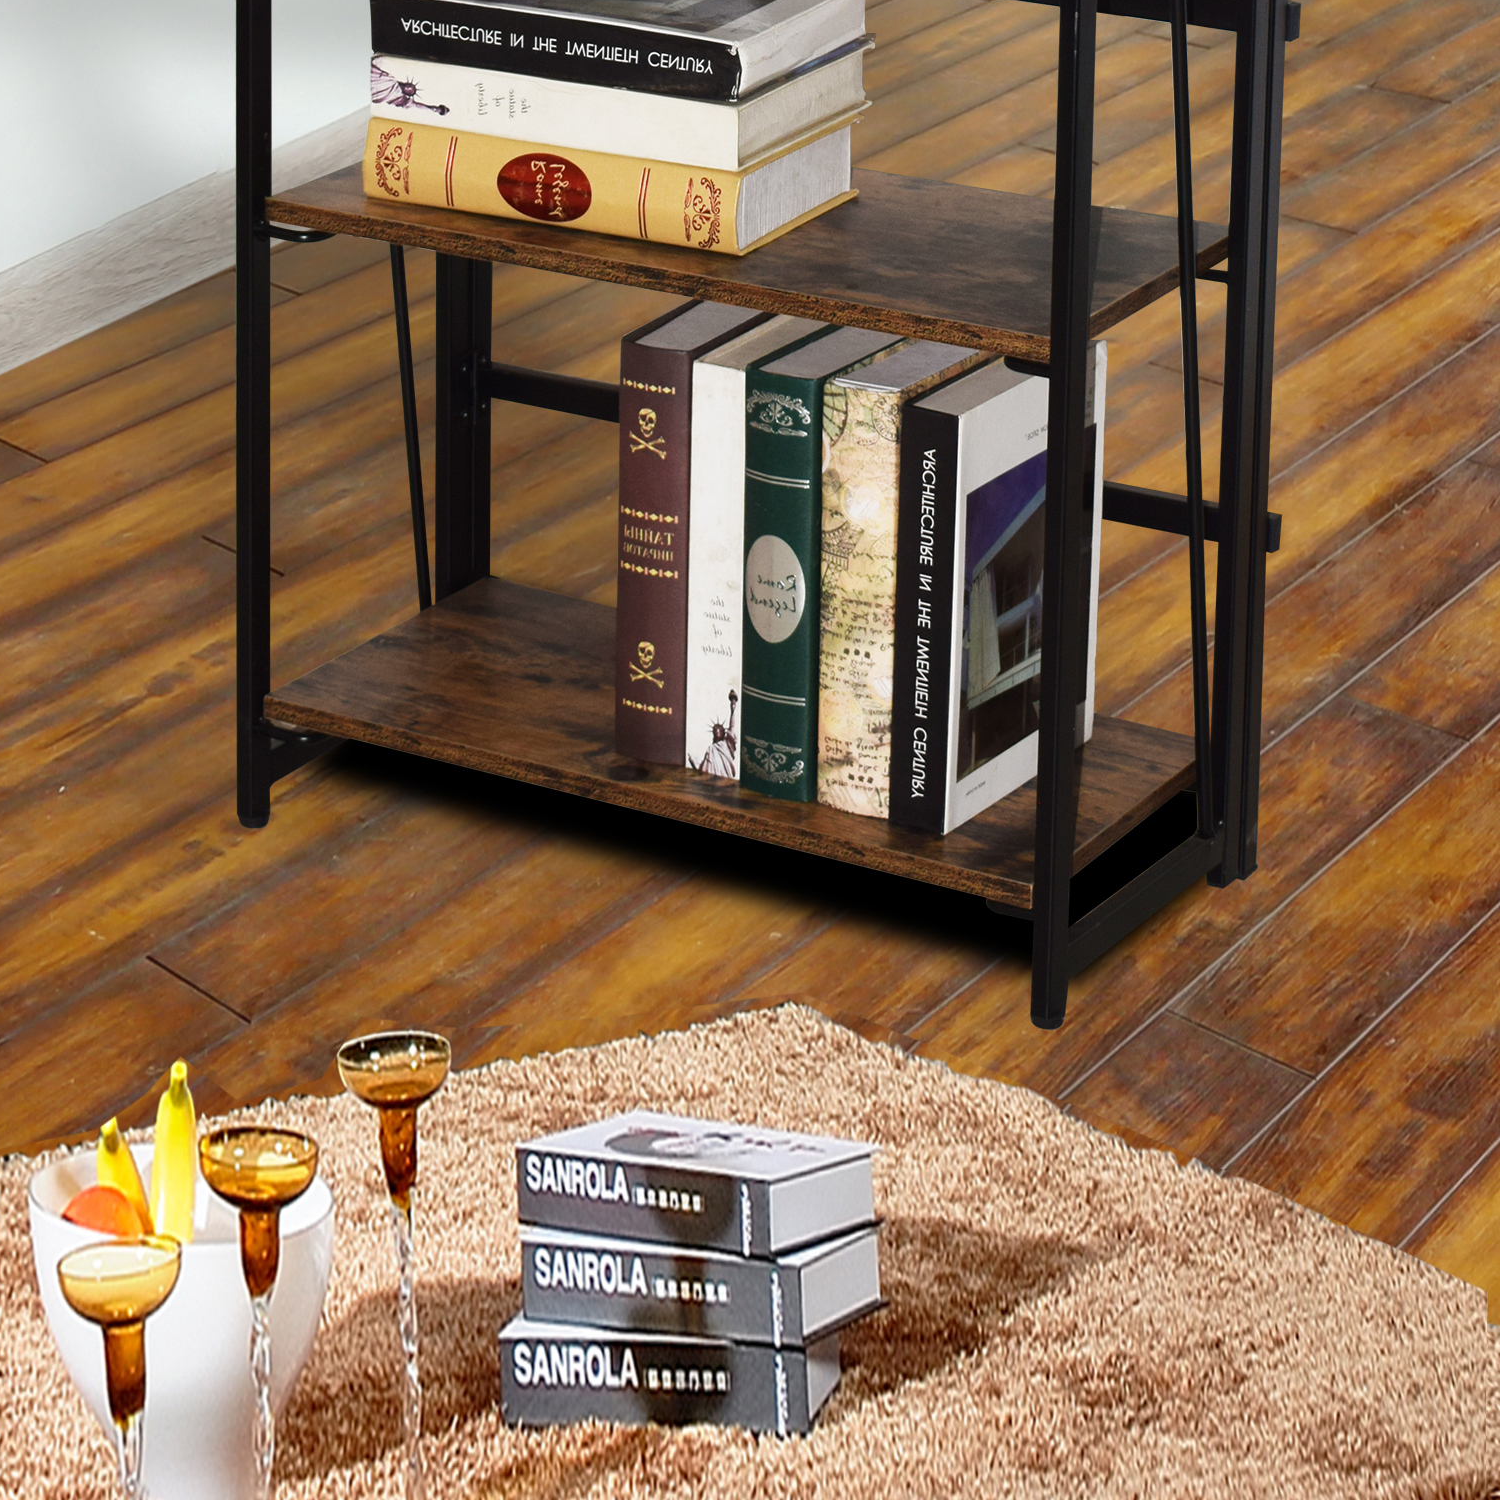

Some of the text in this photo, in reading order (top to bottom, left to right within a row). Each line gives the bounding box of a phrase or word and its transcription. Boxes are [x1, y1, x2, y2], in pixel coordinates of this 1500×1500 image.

[525, 1152, 630, 1203] SANROLA
[534, 1246, 649, 1296] SANROLA
[513, 1342, 639, 1388] SANROLA
